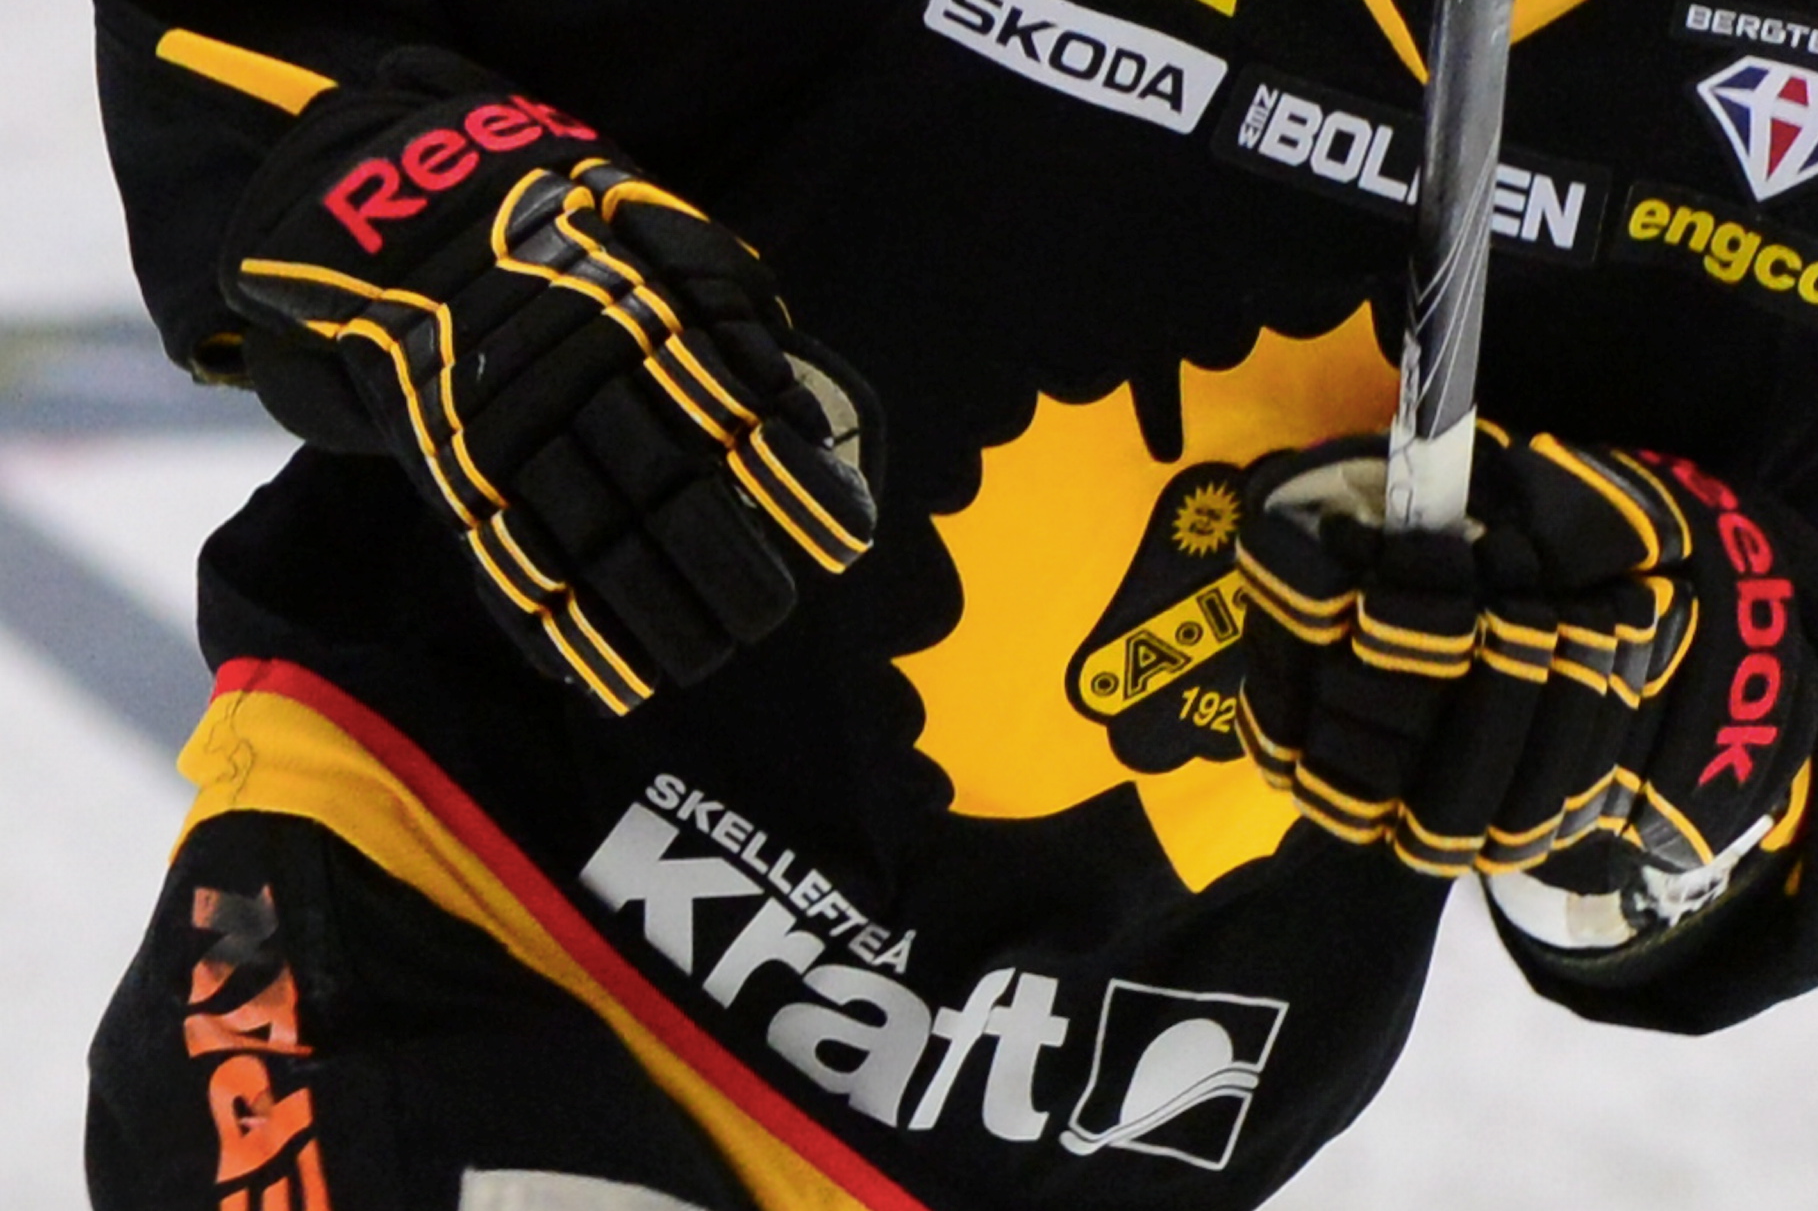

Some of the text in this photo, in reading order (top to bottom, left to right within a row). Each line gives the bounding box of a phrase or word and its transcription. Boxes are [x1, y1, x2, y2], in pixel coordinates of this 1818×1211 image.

[1237, 83, 1587, 250] NEW BOLEN
[578, 800, 1071, 1143] kraft
[644, 772, 917, 975] SKELLEFTEÅ
